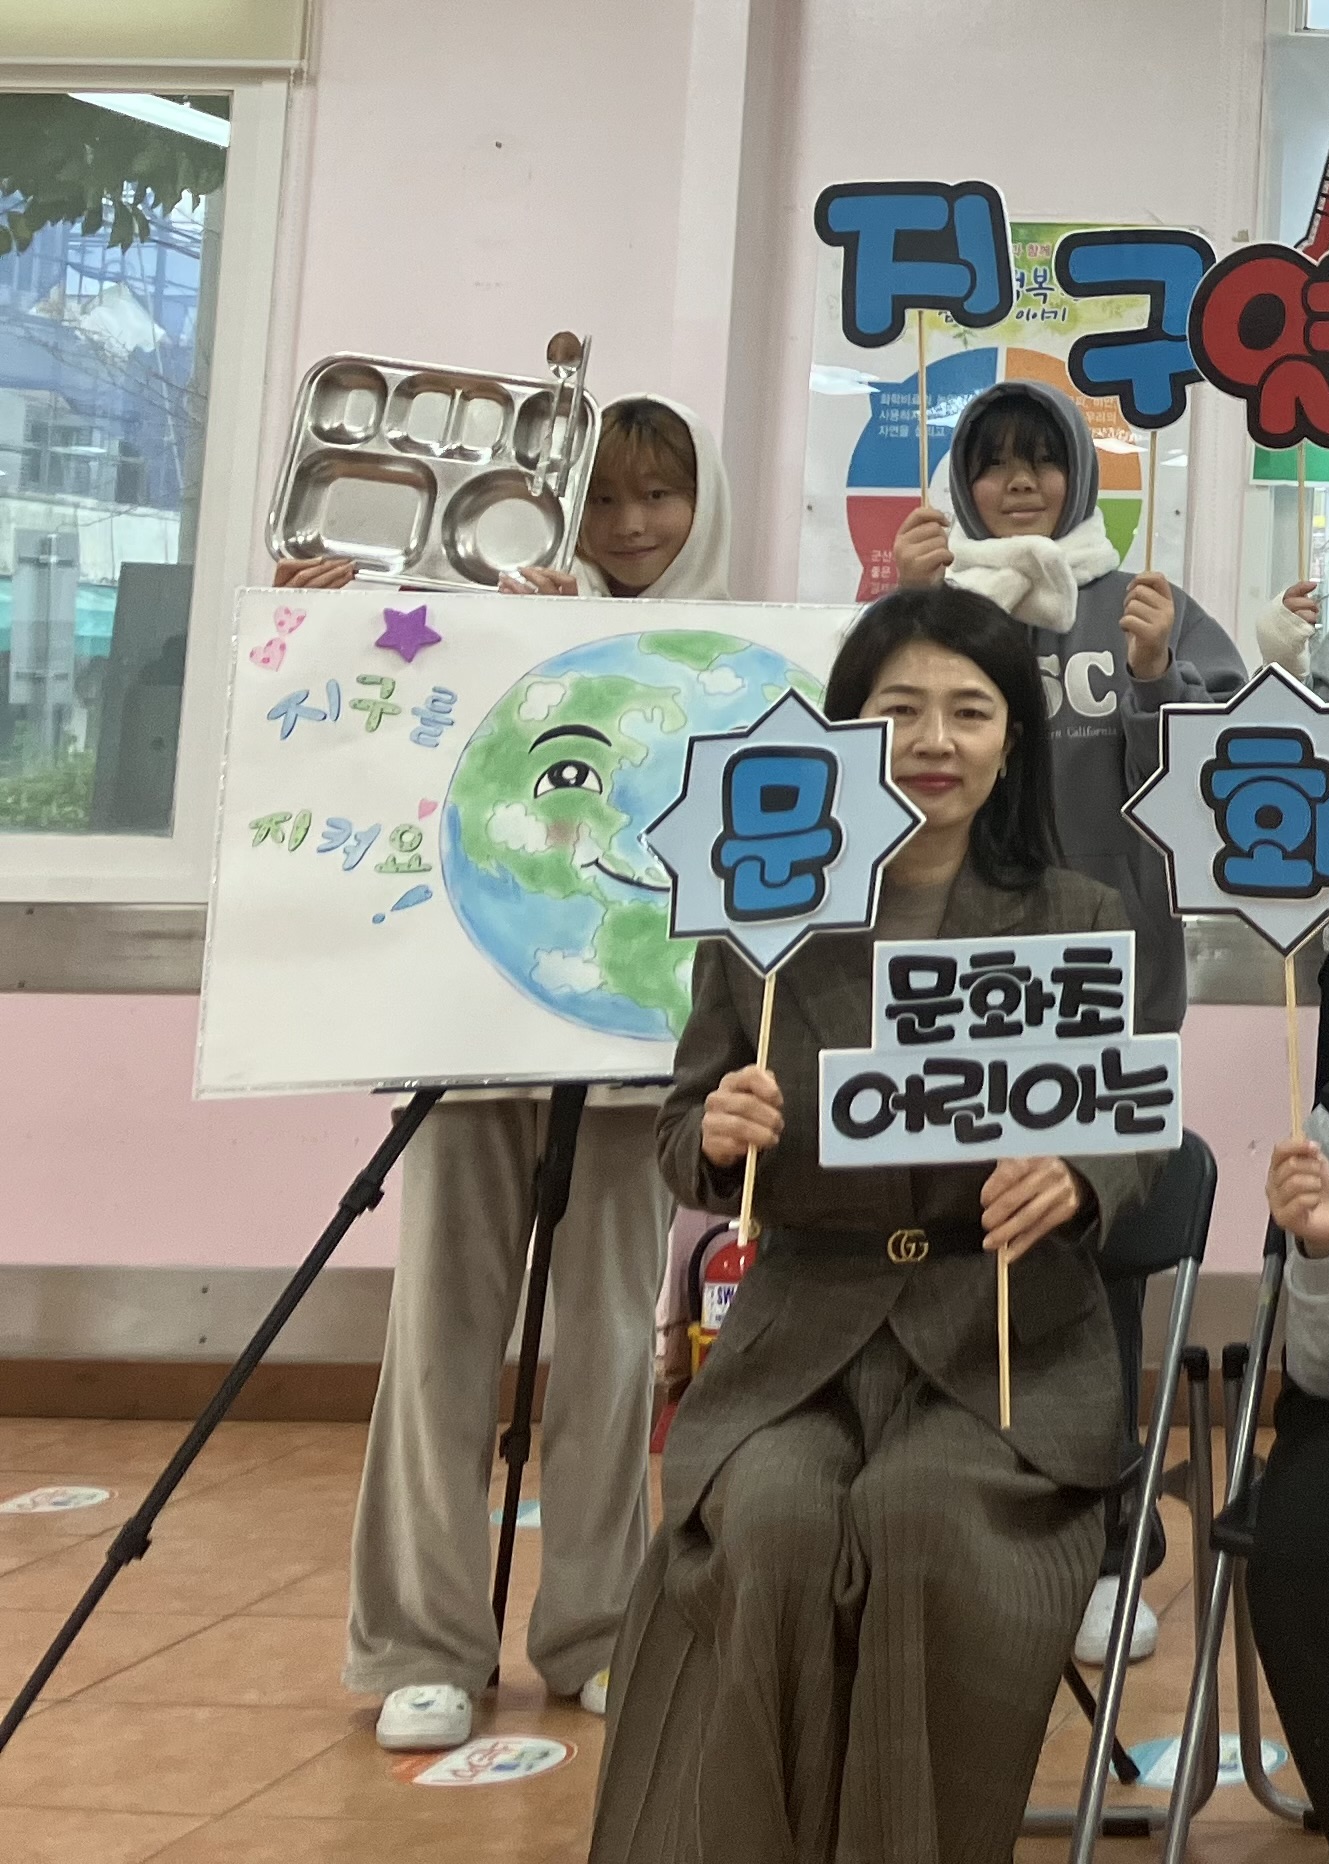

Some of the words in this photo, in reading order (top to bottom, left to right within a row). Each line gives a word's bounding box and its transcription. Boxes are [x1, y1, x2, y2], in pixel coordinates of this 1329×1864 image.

[1016, 307, 1067, 321] 이야기
[267, 674, 458, 748] 지구를
[712, 745, 842, 921] 문
[885, 947, 1125, 1045] 문화초
[831, 1047, 1174, 1144] 어린이는
